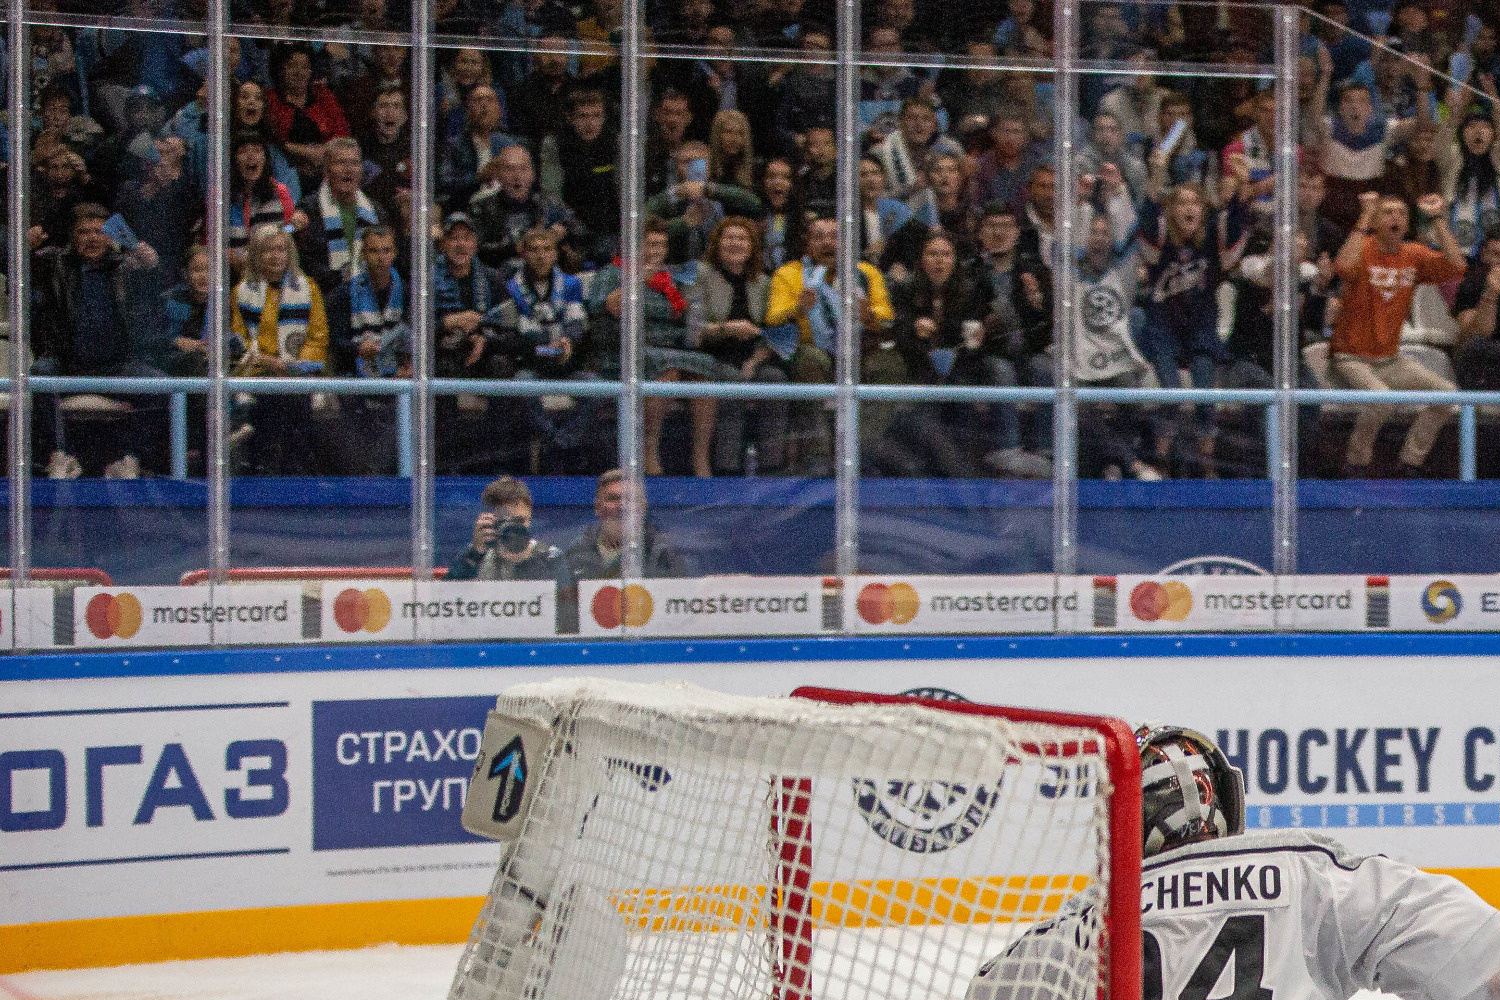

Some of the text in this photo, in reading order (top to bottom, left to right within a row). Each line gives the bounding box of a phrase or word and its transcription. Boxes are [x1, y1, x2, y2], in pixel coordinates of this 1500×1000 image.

[153, 600, 288, 624] mastercard
[402, 595, 543, 620] mastercard
[665, 592, 809, 616] mastercard
[931, 590, 1078, 613] mastercard
[1204, 589, 1352, 611] mastercard
[1216, 727, 1442, 795] HOCKEY
